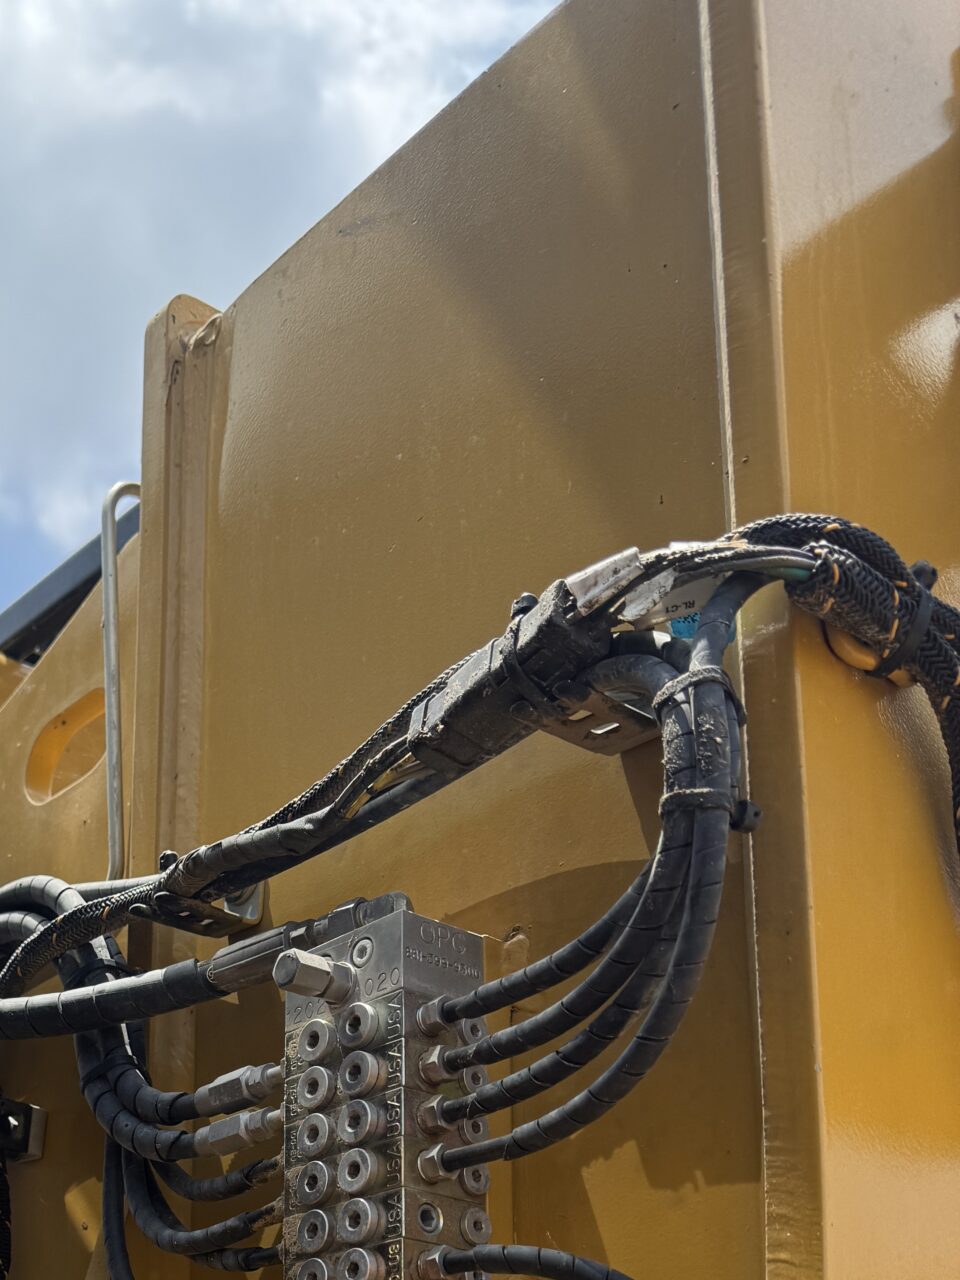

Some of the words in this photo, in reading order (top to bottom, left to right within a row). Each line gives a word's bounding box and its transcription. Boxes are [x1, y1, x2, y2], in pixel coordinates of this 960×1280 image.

[664, 600, 696, 614] RL-C1
[387, 993, 401, 1037] USA
[387, 1045, 401, 1087] USA
[387, 1095, 401, 1137] USA
[387, 1142, 401, 1187] USA
[387, 1194, 401, 1237] USA
